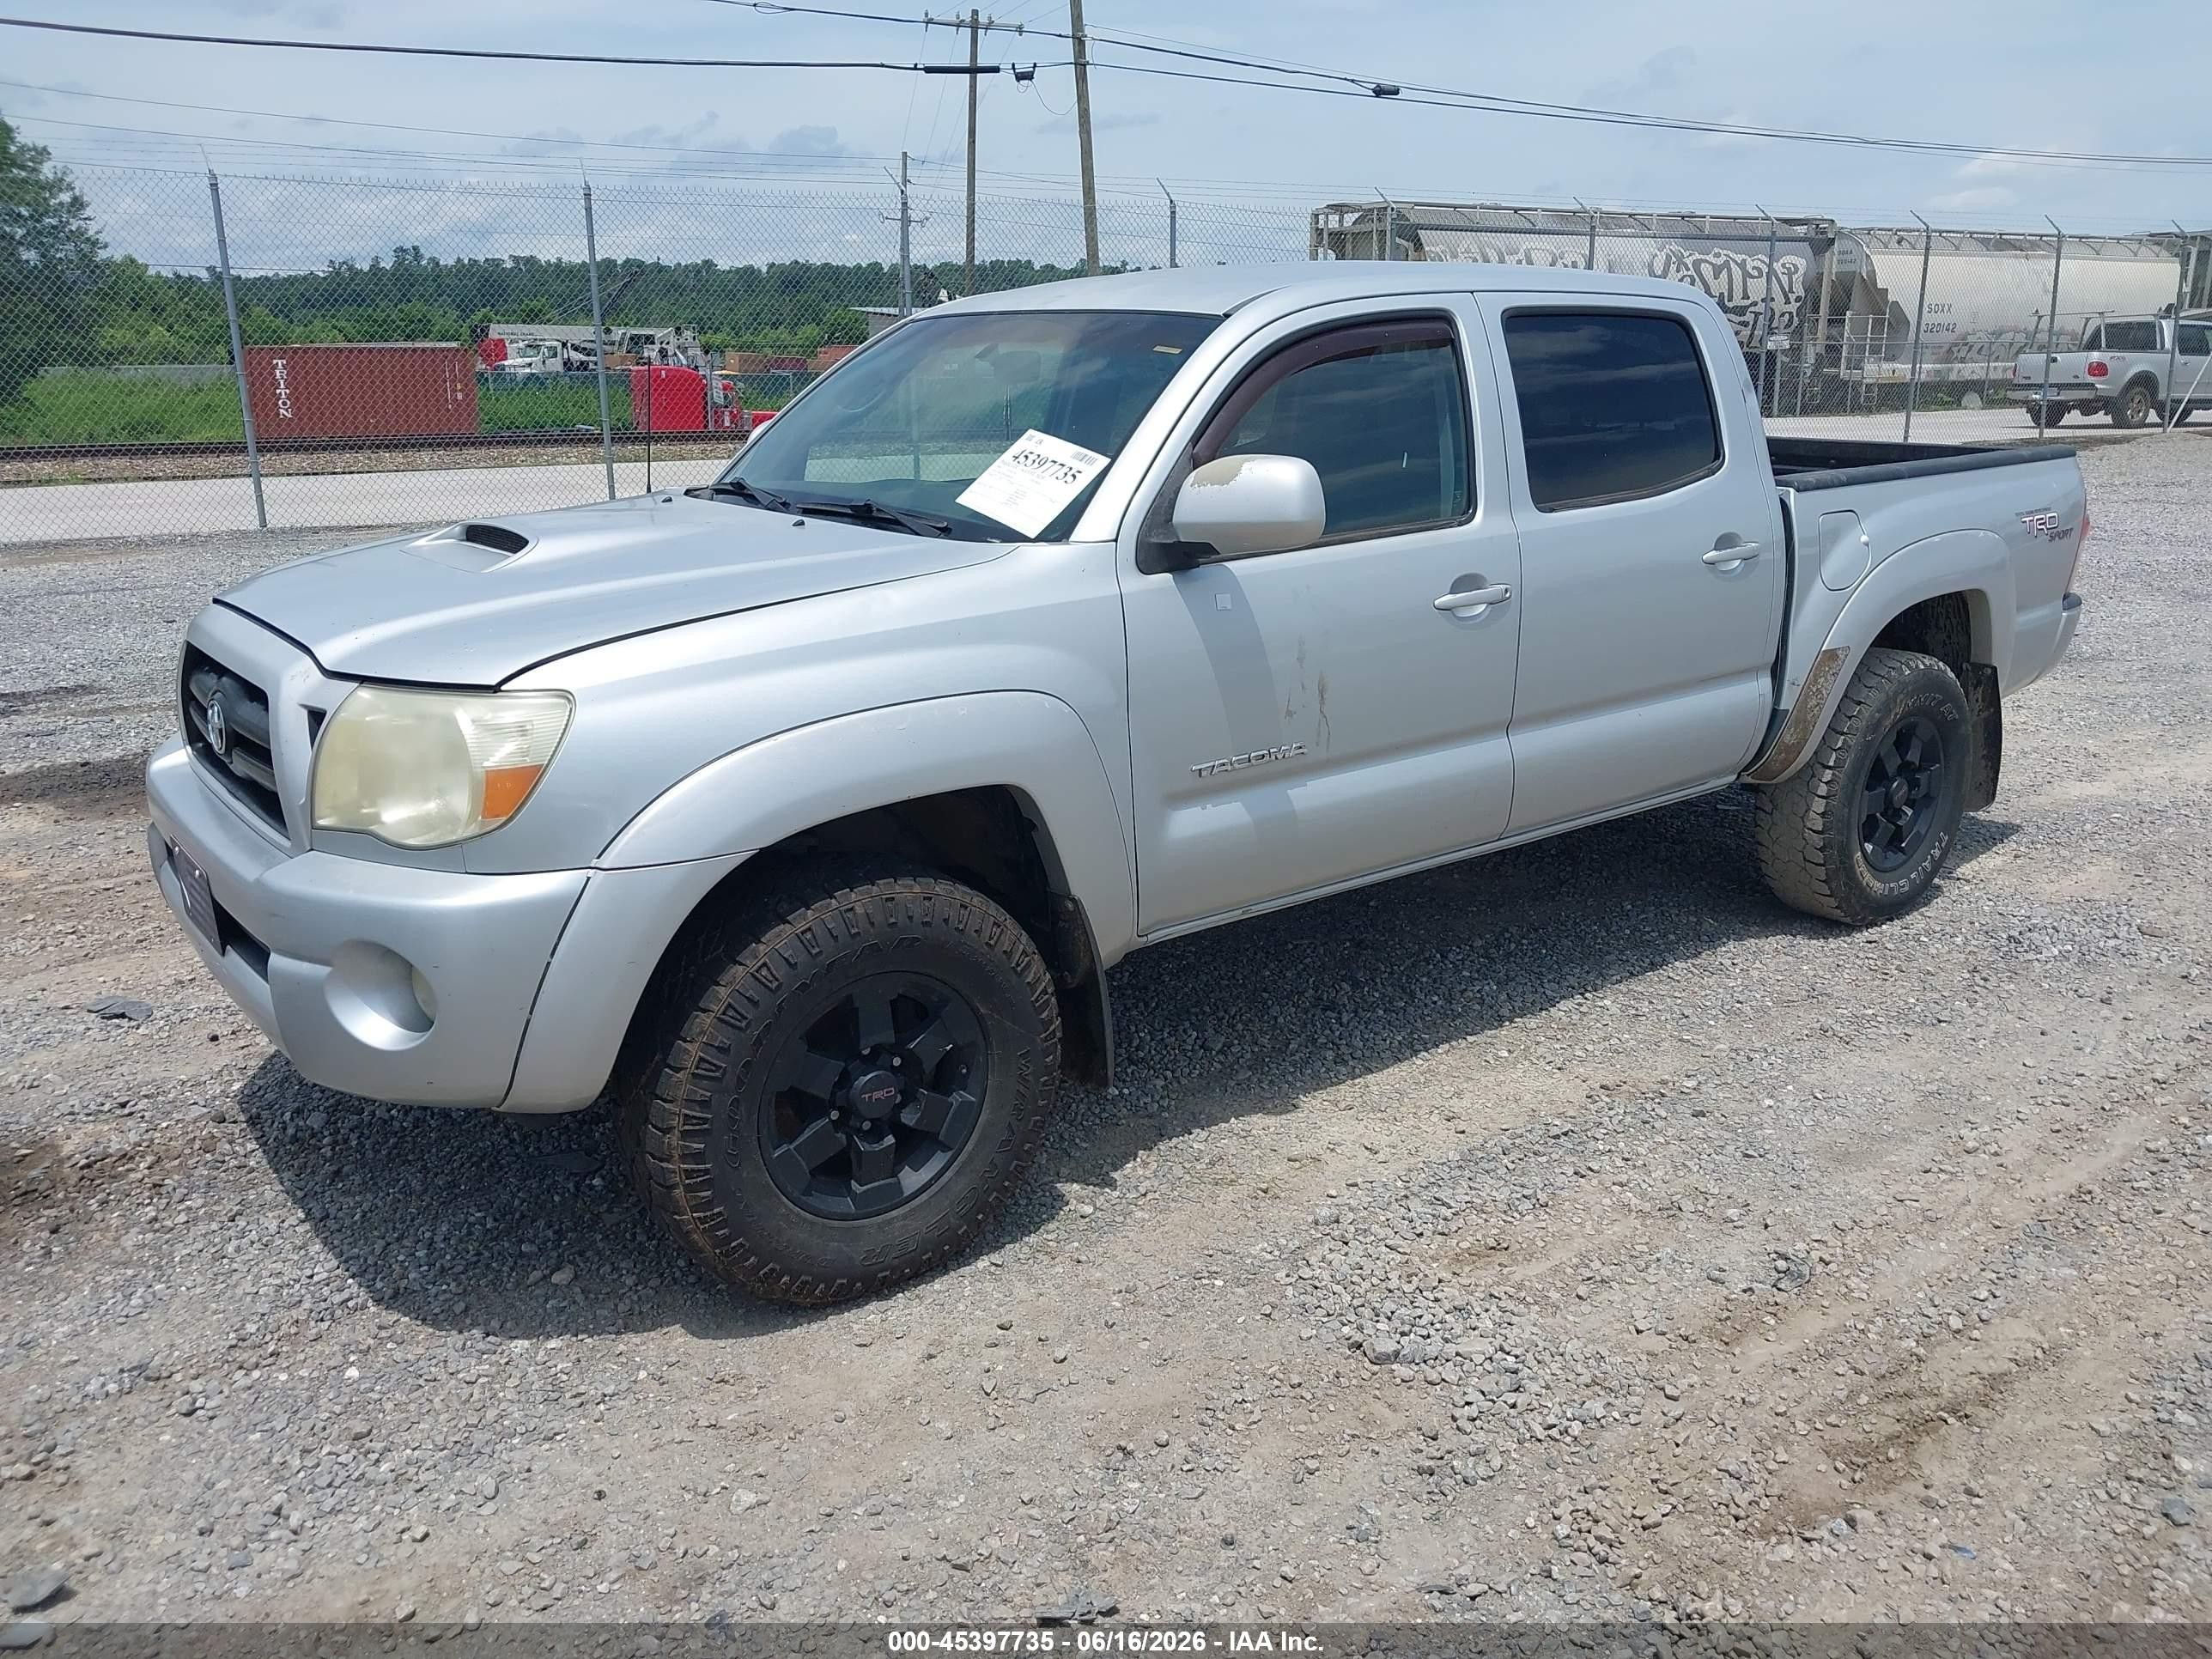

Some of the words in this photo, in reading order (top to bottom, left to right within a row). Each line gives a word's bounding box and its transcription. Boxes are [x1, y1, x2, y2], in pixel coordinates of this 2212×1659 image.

[1926, 303, 1953, 314] SOXX
[1923, 323, 1957, 333] 320142
[272, 359, 293, 418] TRITON
[1012, 448, 1083, 484] 45397735
[2020, 511, 2059, 538] TRD
[2047, 527, 2075, 543] SPORT
[1190, 741, 1309, 778] TACOMA
[1911, 831, 1949, 884] TRAIL
[860, 1086, 896, 1103] TRD
[859, 1047, 1032, 1267] WRANGLER
